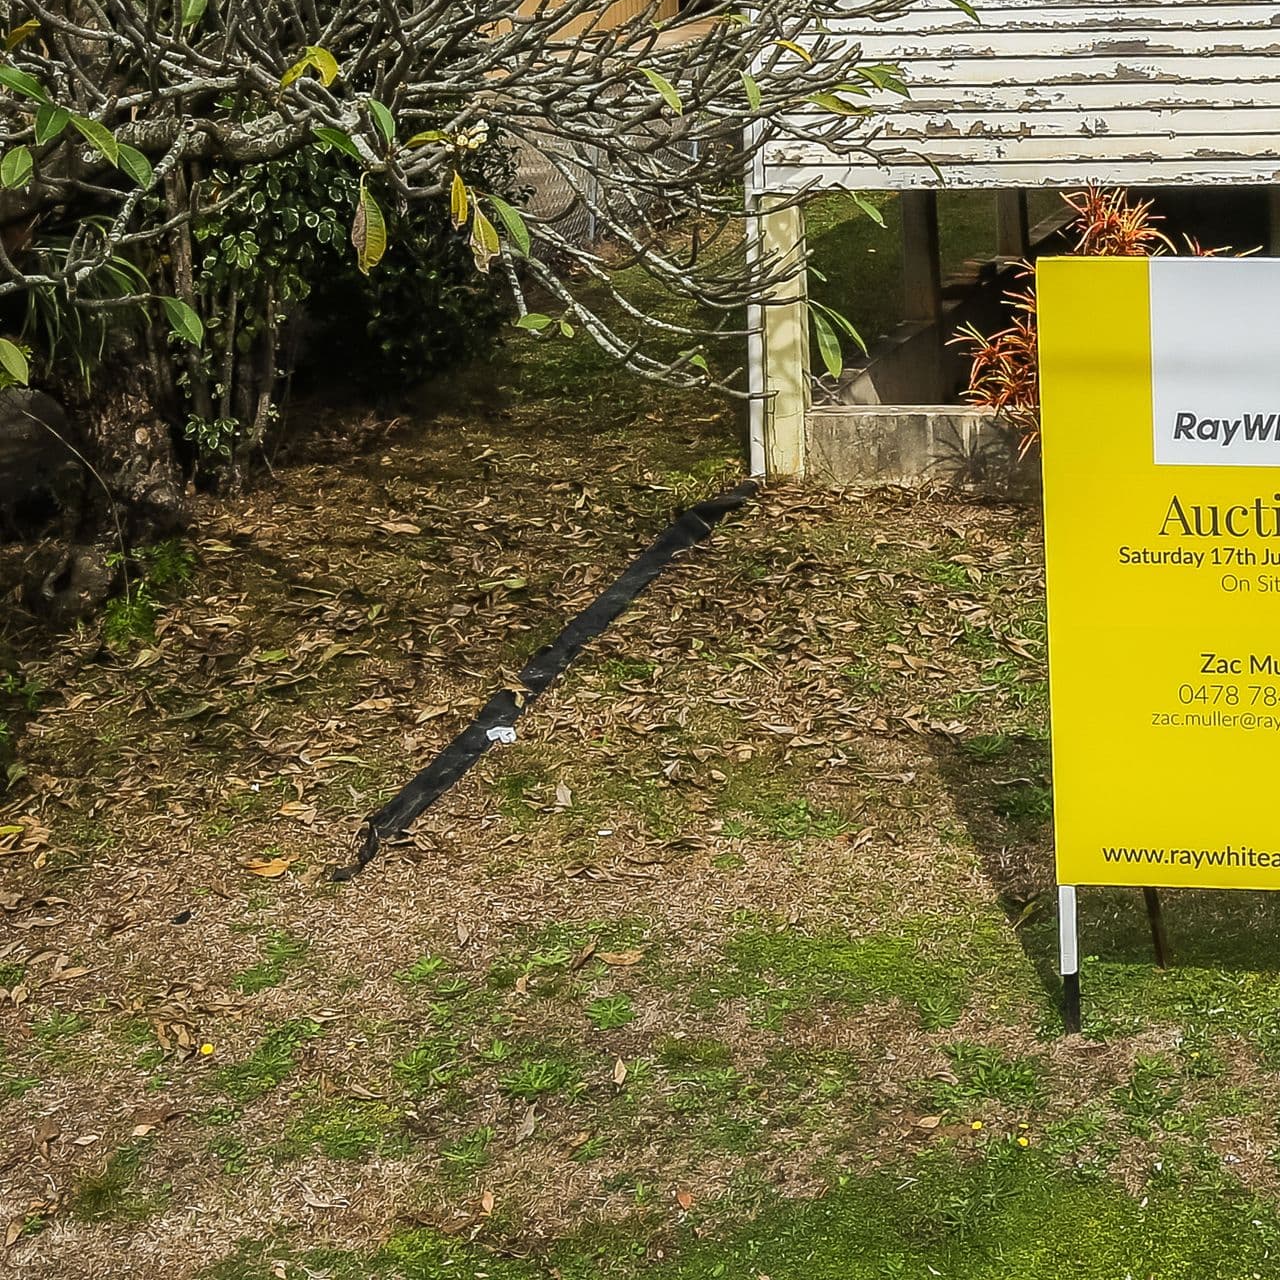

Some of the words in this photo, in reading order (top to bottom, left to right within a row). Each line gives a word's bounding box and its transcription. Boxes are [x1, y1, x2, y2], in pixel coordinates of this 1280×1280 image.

[1119, 547, 1205, 568] Saturday
[1211, 548, 1256, 566] 17th
[1221, 574, 1250, 592] On
[1200, 654, 1242, 675] Zac
[1179, 684, 1240, 706] 0478
